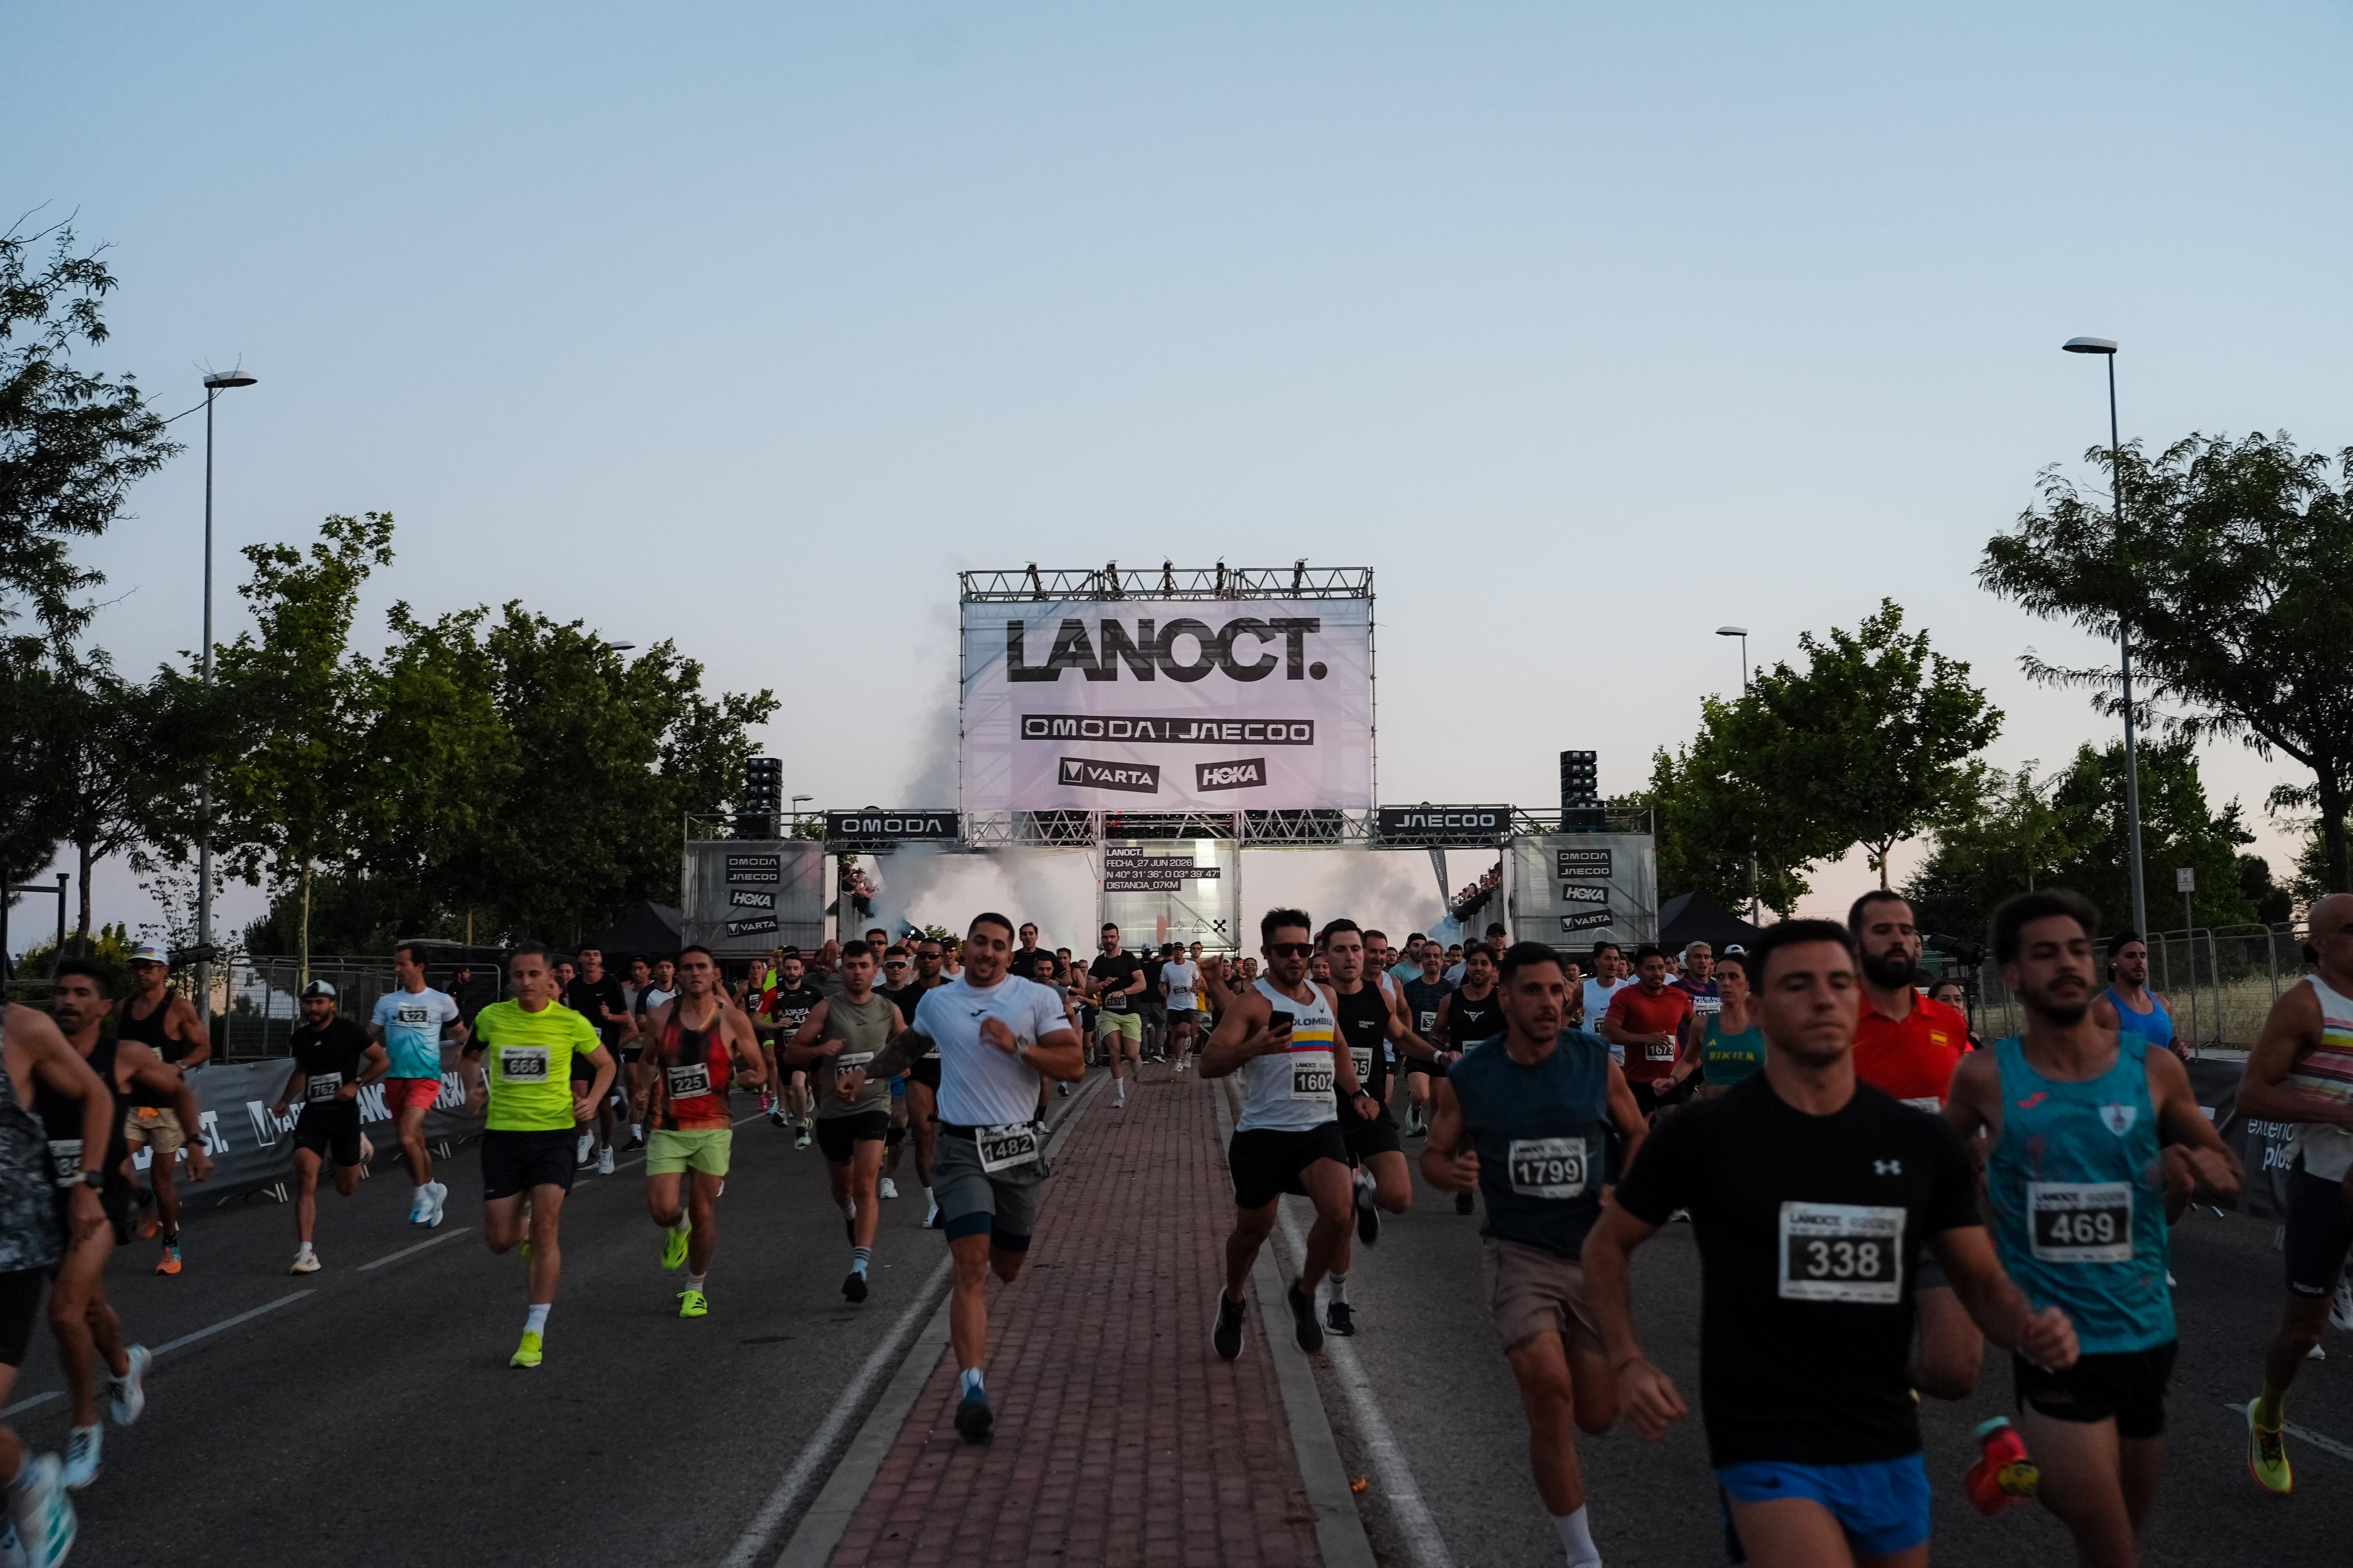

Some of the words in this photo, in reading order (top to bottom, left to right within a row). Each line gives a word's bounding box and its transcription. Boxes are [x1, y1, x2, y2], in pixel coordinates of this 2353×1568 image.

[1007, 618, 1328, 682] LANOCT.
[1025, 719, 1156, 738] OMODA
[1179, 723, 1309, 741] JAECOO
[1087, 767, 1153, 785] VARTA
[1203, 765, 1258, 785] HOKA
[842, 819, 942, 832] OMODA
[1395, 814, 1495, 827] JAECOO
[733, 892, 771, 907] HOKA
[1566, 887, 1604, 901] HOKA
[740, 920, 775, 932] VARTA
[1575, 914, 1611, 925] VARTA
[510, 1059, 540, 1074] 666
[313, 1083, 336, 1096] 762
[675, 1076, 702, 1091] 225
[984, 1136, 1031, 1161] 1482
[1518, 1158, 1579, 1184] 1799
[2050, 1212, 2115, 1244] 469
[1806, 1240, 1880, 1278] 338
